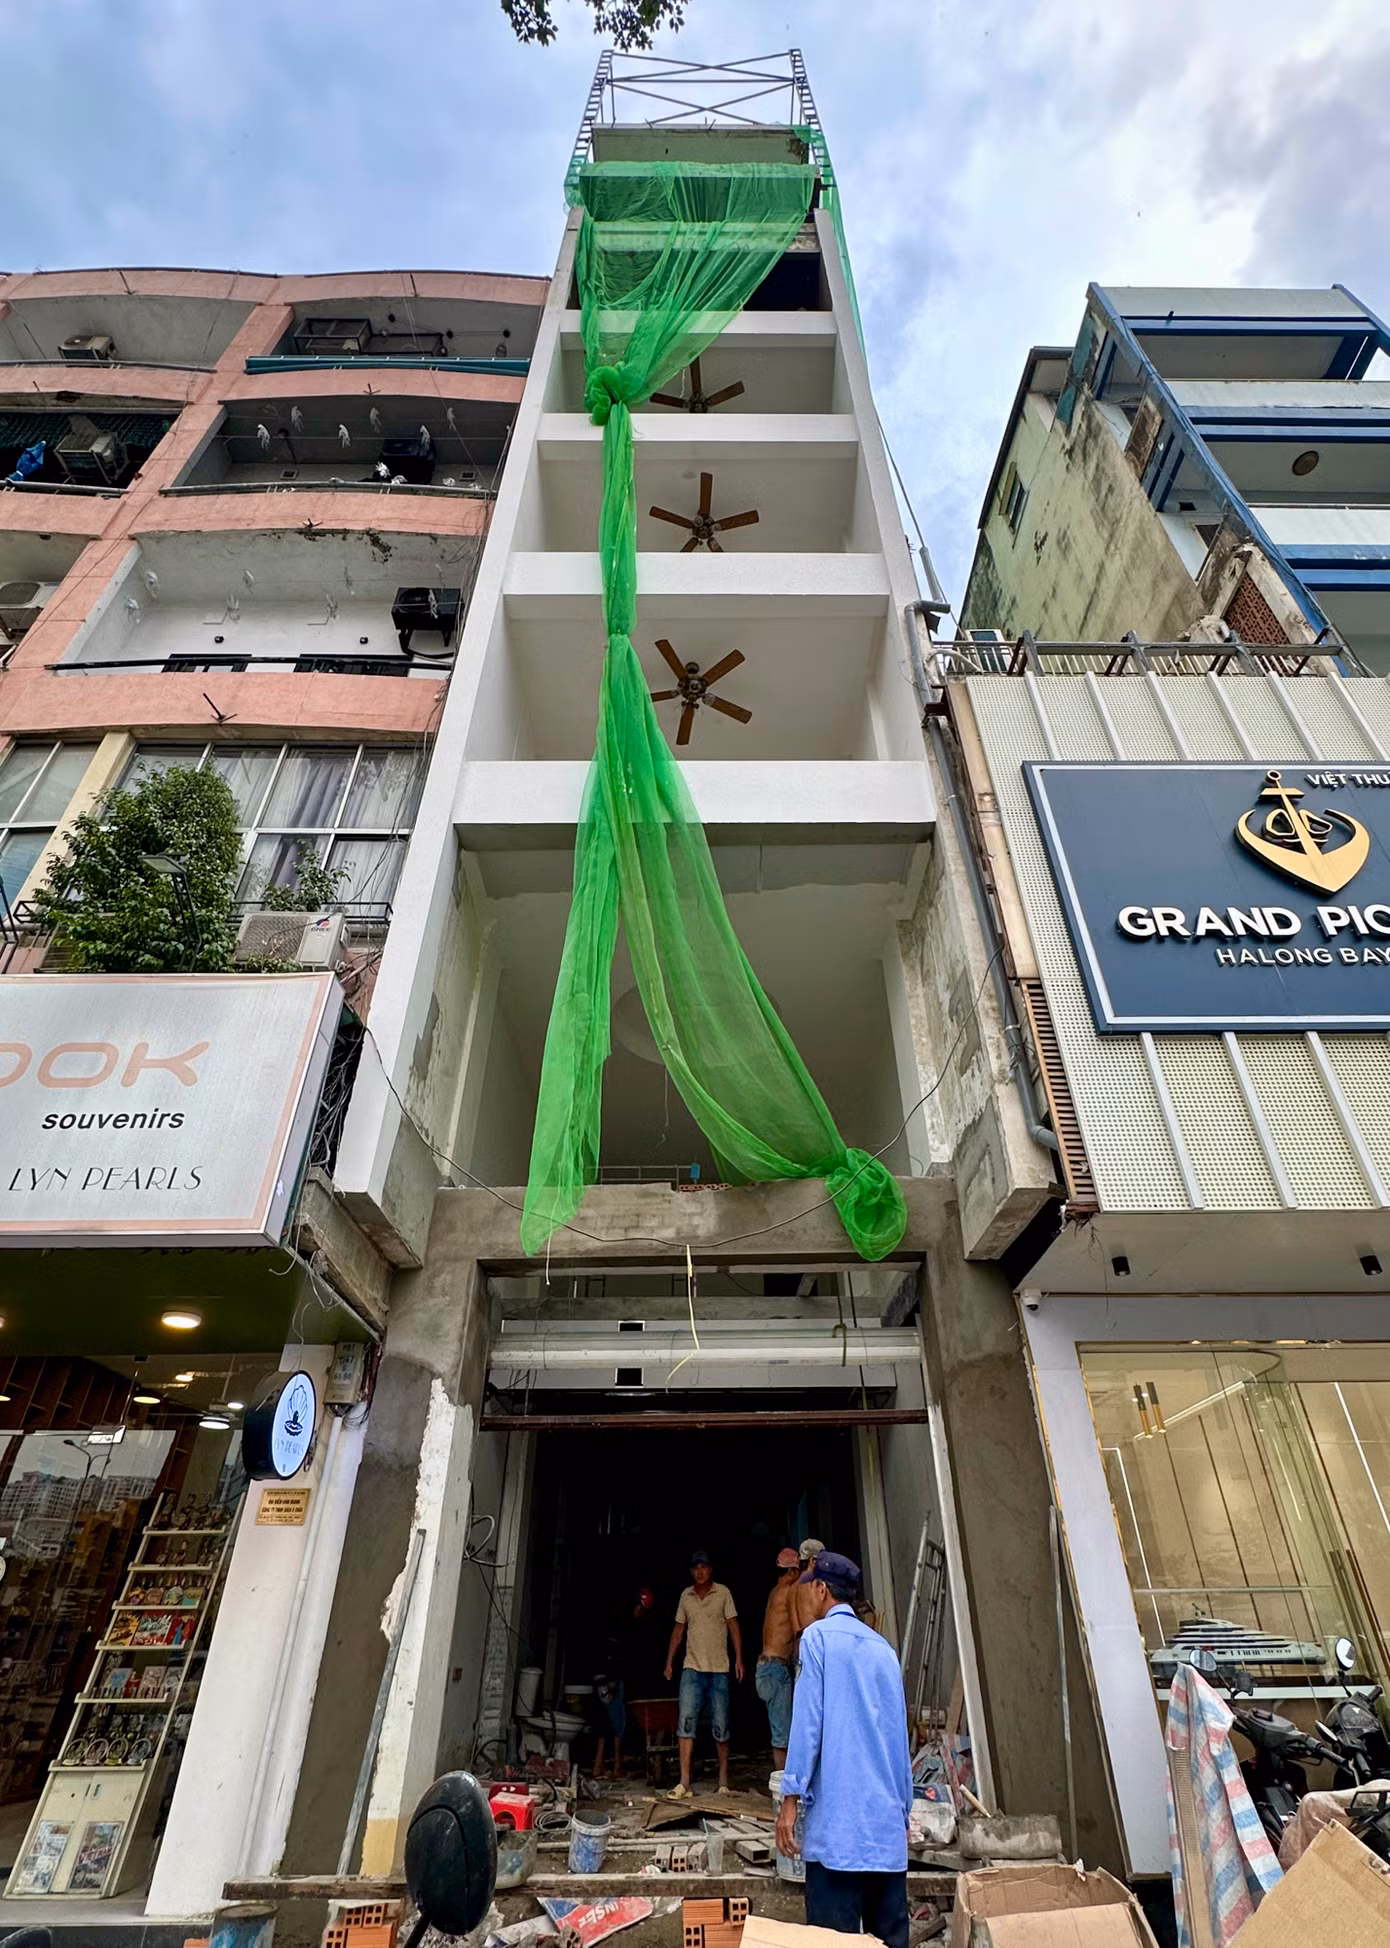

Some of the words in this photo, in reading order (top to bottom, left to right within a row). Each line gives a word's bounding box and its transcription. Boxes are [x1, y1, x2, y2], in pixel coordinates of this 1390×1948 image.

[1305, 771, 1347, 787] VIỆT
[1117, 905, 1302, 938] GRAND
[1216, 947, 1333, 966] HALONG
[1338, 947, 1390, 965] BAY
[41, 1107, 186, 1130] souvenirs
[8, 1166, 72, 1191] LYN
[81, 1165, 204, 1191] PEARLS
